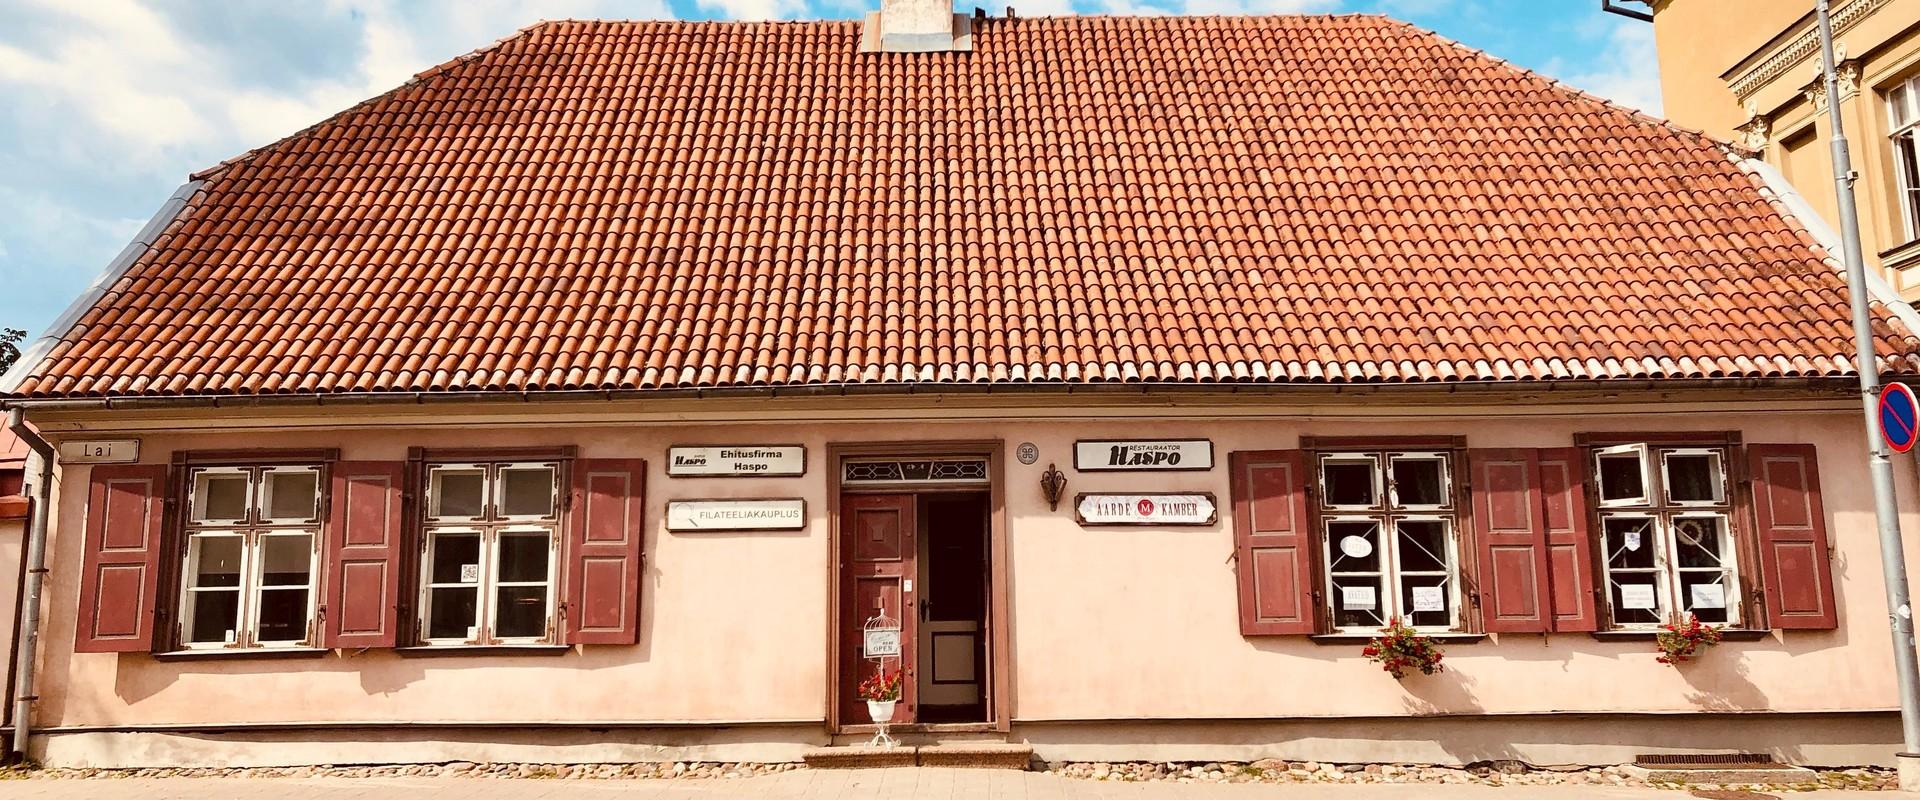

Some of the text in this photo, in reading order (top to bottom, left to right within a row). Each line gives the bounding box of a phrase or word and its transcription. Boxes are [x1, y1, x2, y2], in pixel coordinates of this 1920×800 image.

[84, 443, 112, 457] Lai
[720, 450, 783, 459] Ehitusfirma
[1108, 445, 1181, 465] HASPO
[734, 462, 768, 472] Haspo
[699, 509, 800, 519] FILATEELIAKAUPLUS
[1097, 502, 1198, 517] AARDE M KAMBER
